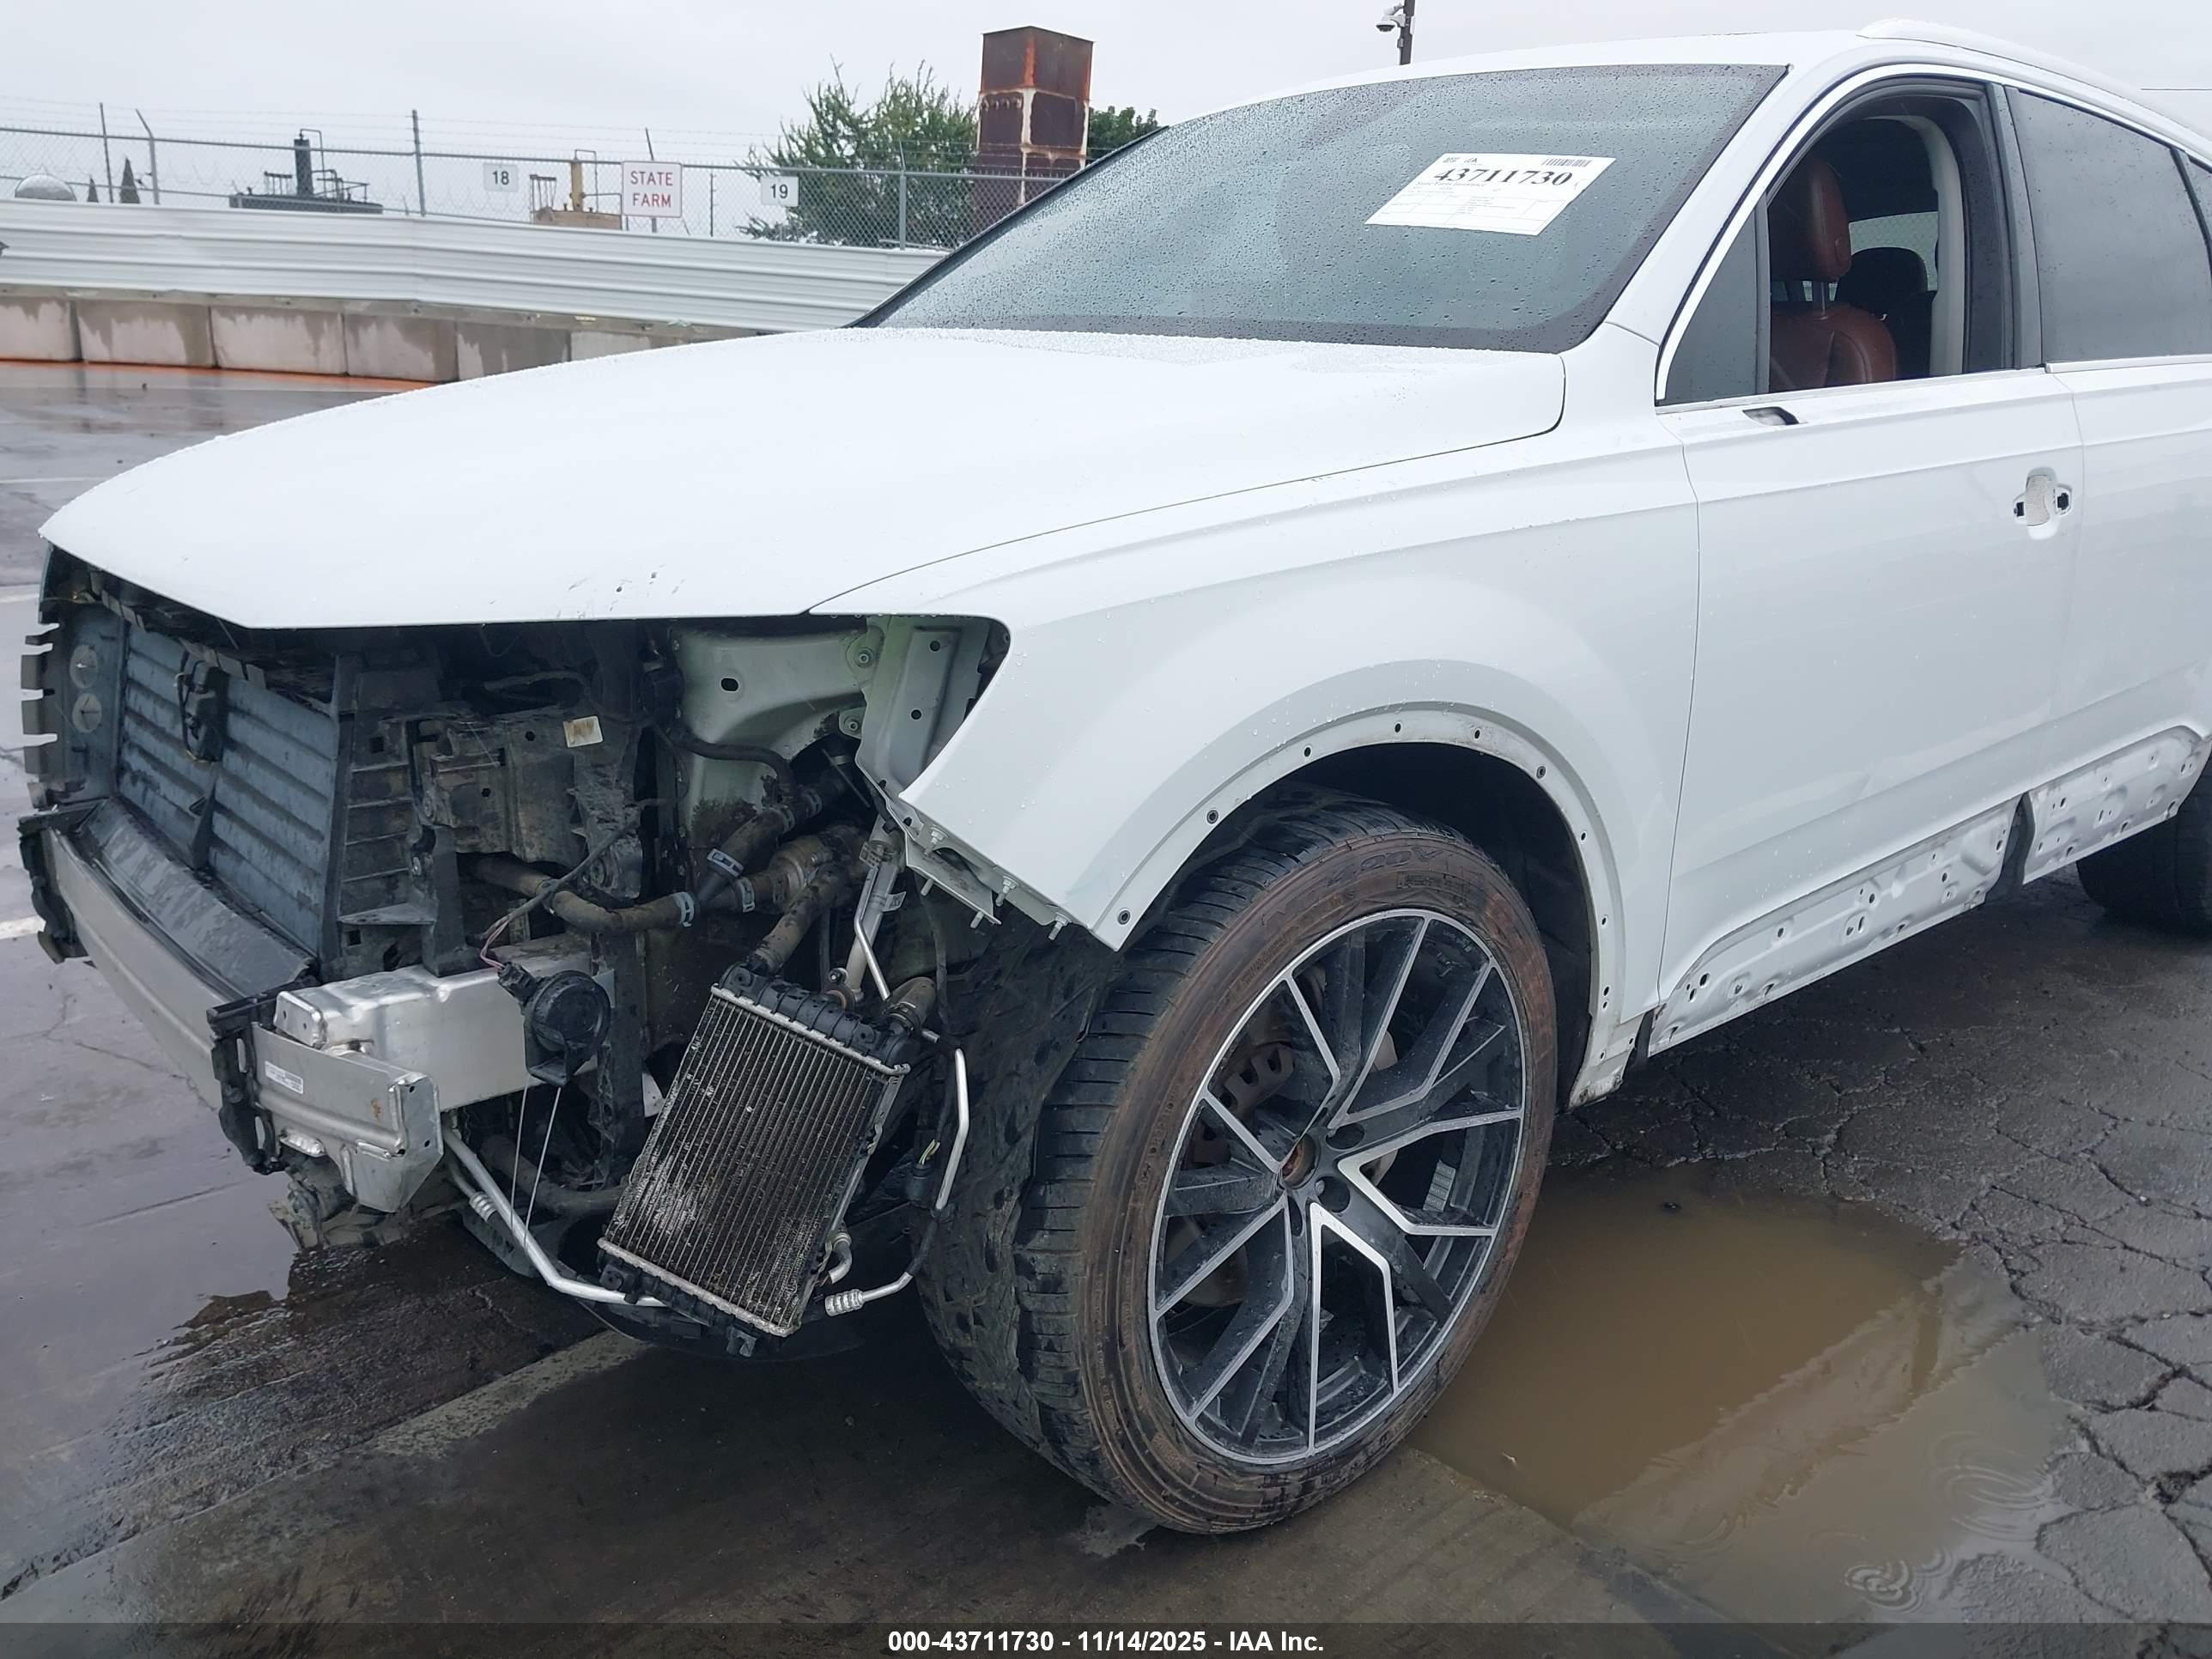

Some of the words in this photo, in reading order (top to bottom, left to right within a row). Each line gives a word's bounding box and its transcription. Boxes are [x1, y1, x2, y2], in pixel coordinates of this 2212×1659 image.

[492, 170, 510, 185] 18
[630, 170, 674, 186] STATE
[1433, 167, 1573, 186] 43711730
[769, 183, 788, 199] 19
[632, 192, 672, 208] FARM
